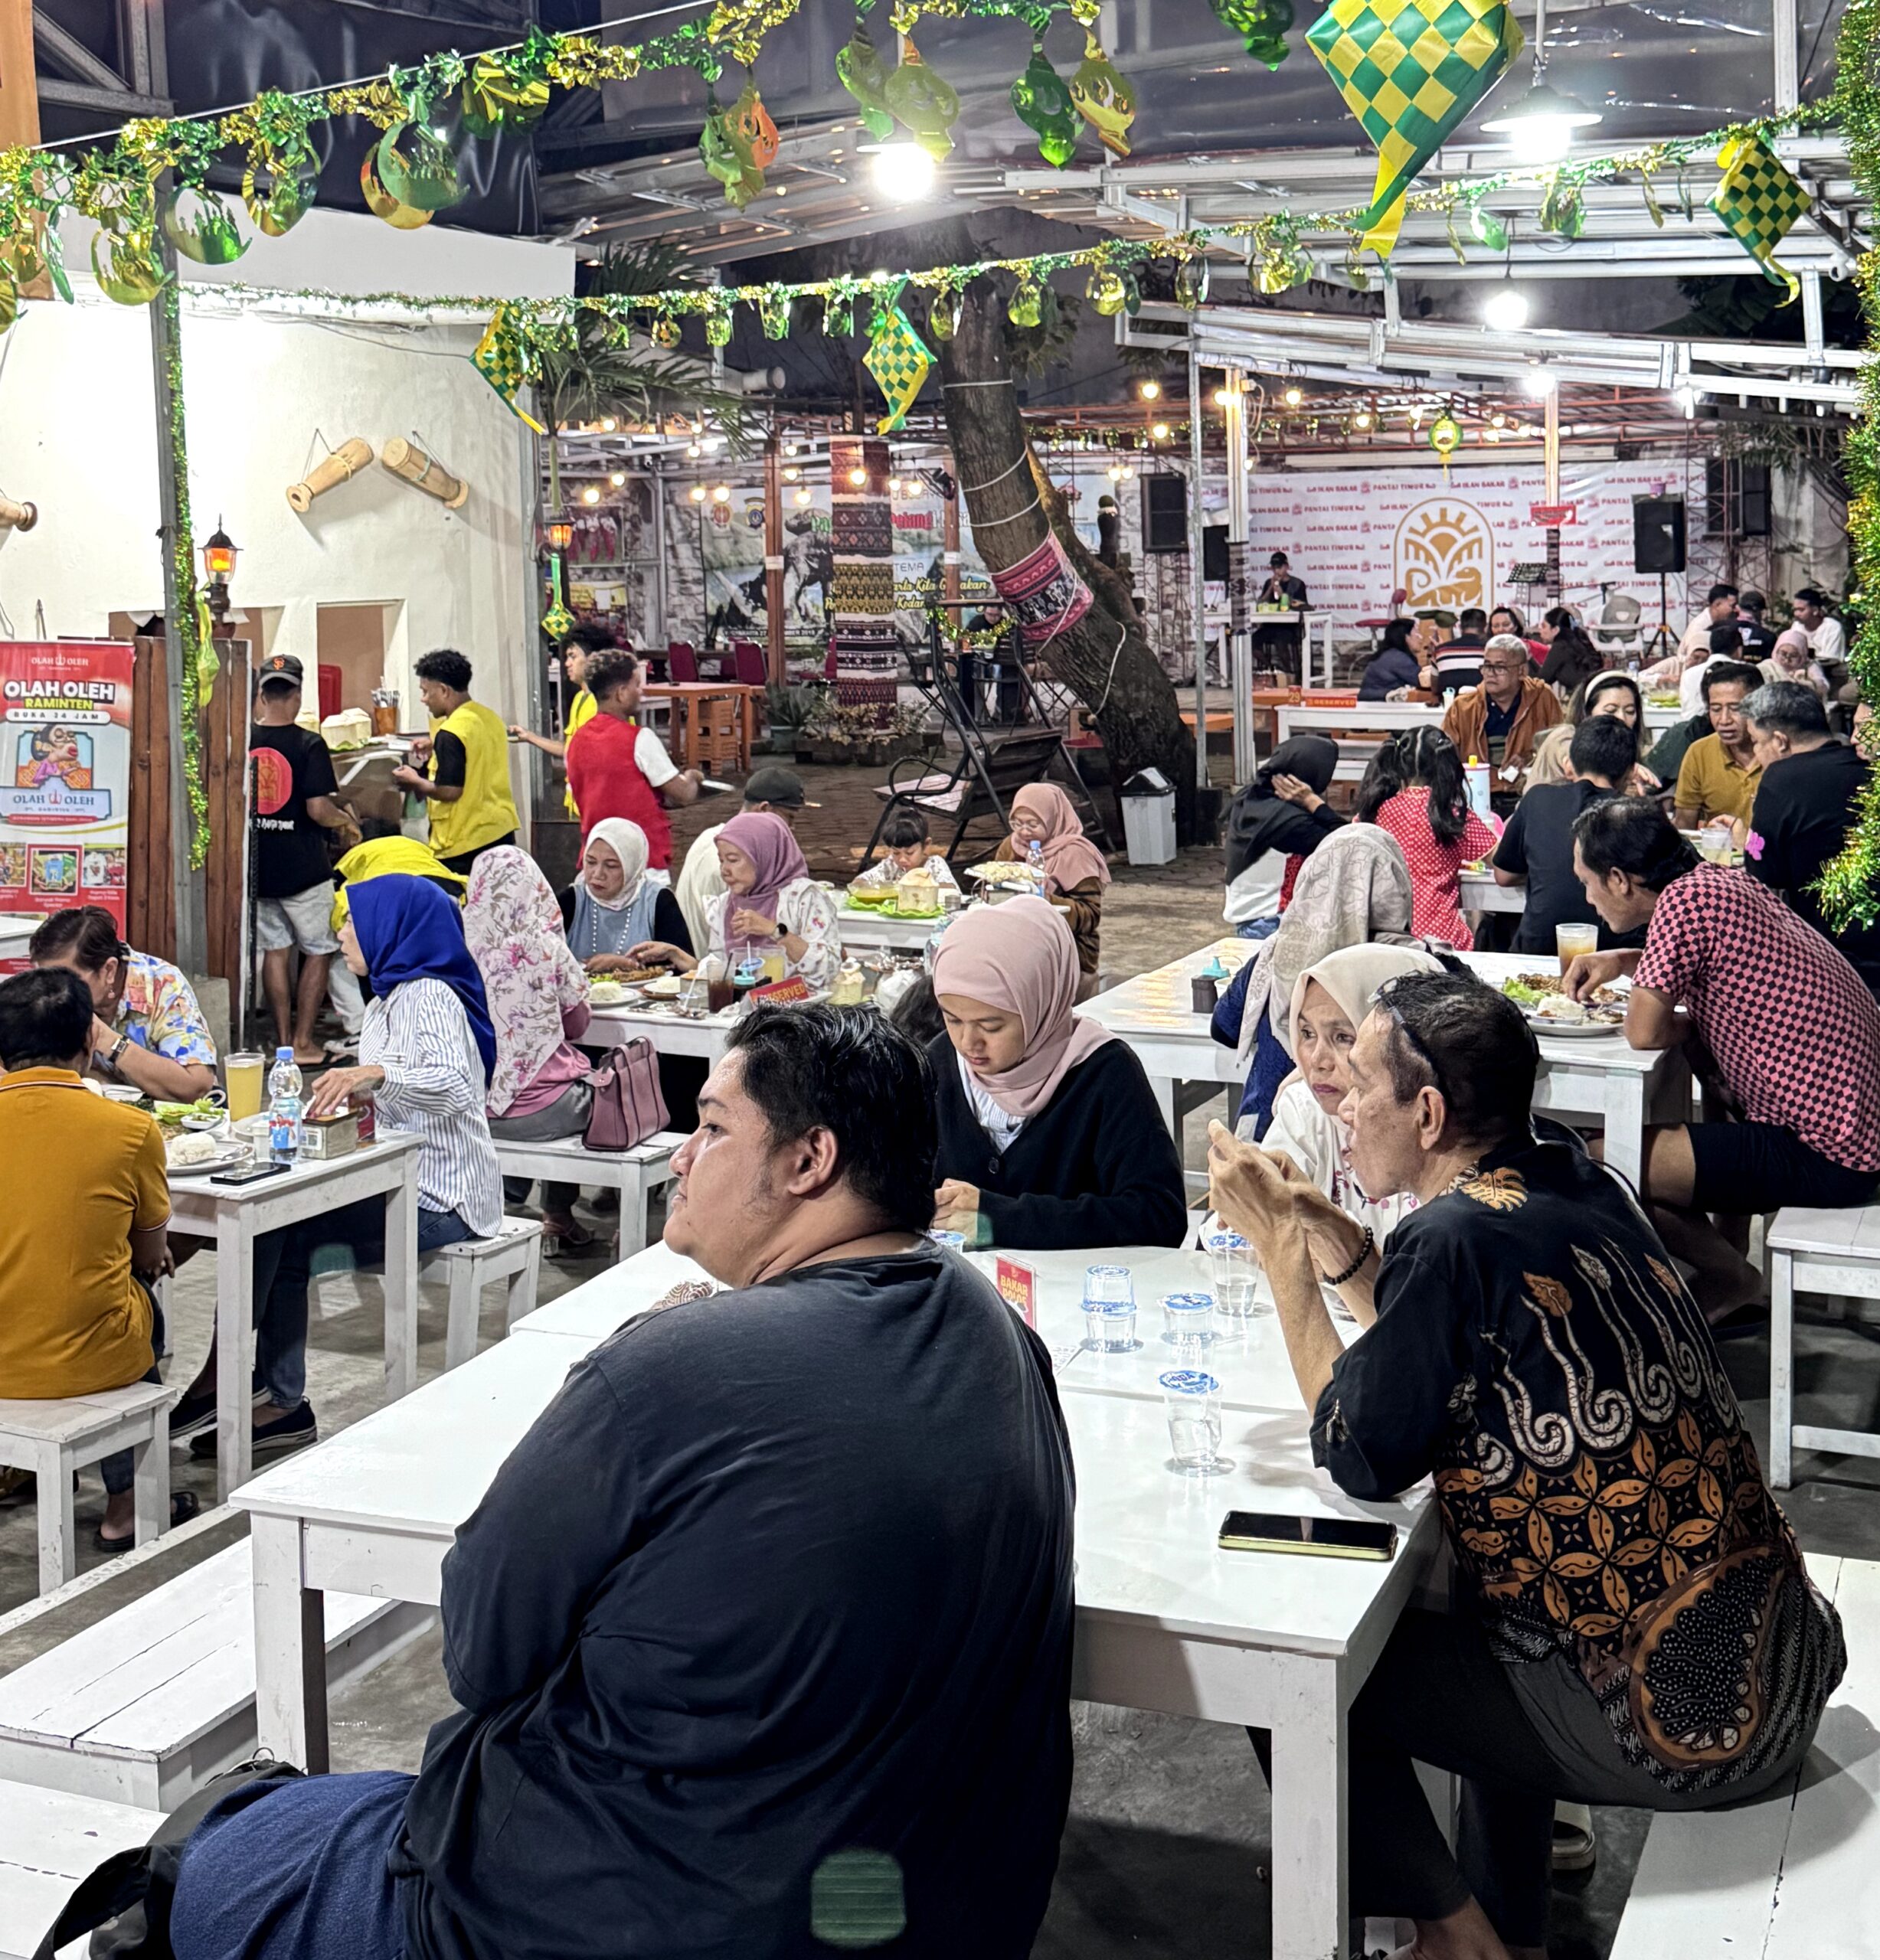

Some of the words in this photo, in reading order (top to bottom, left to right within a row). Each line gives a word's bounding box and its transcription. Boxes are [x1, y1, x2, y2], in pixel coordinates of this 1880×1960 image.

[894, 563, 924, 572] TEMA
[916, 577, 936, 592] Kita
[31, 657, 54, 665] OLAH
[67, 658, 89, 666] OLEH
[5, 681, 60, 697] OLAH
[63, 681, 114, 701] OLEH
[1290, 691, 1300, 703] 29
[25, 697, 93, 710] RAMINTEN
[13, 795, 44, 804] OLAH
[64, 795, 94, 805] OLEH
[1000, 1275, 1028, 1296] BAKAR
